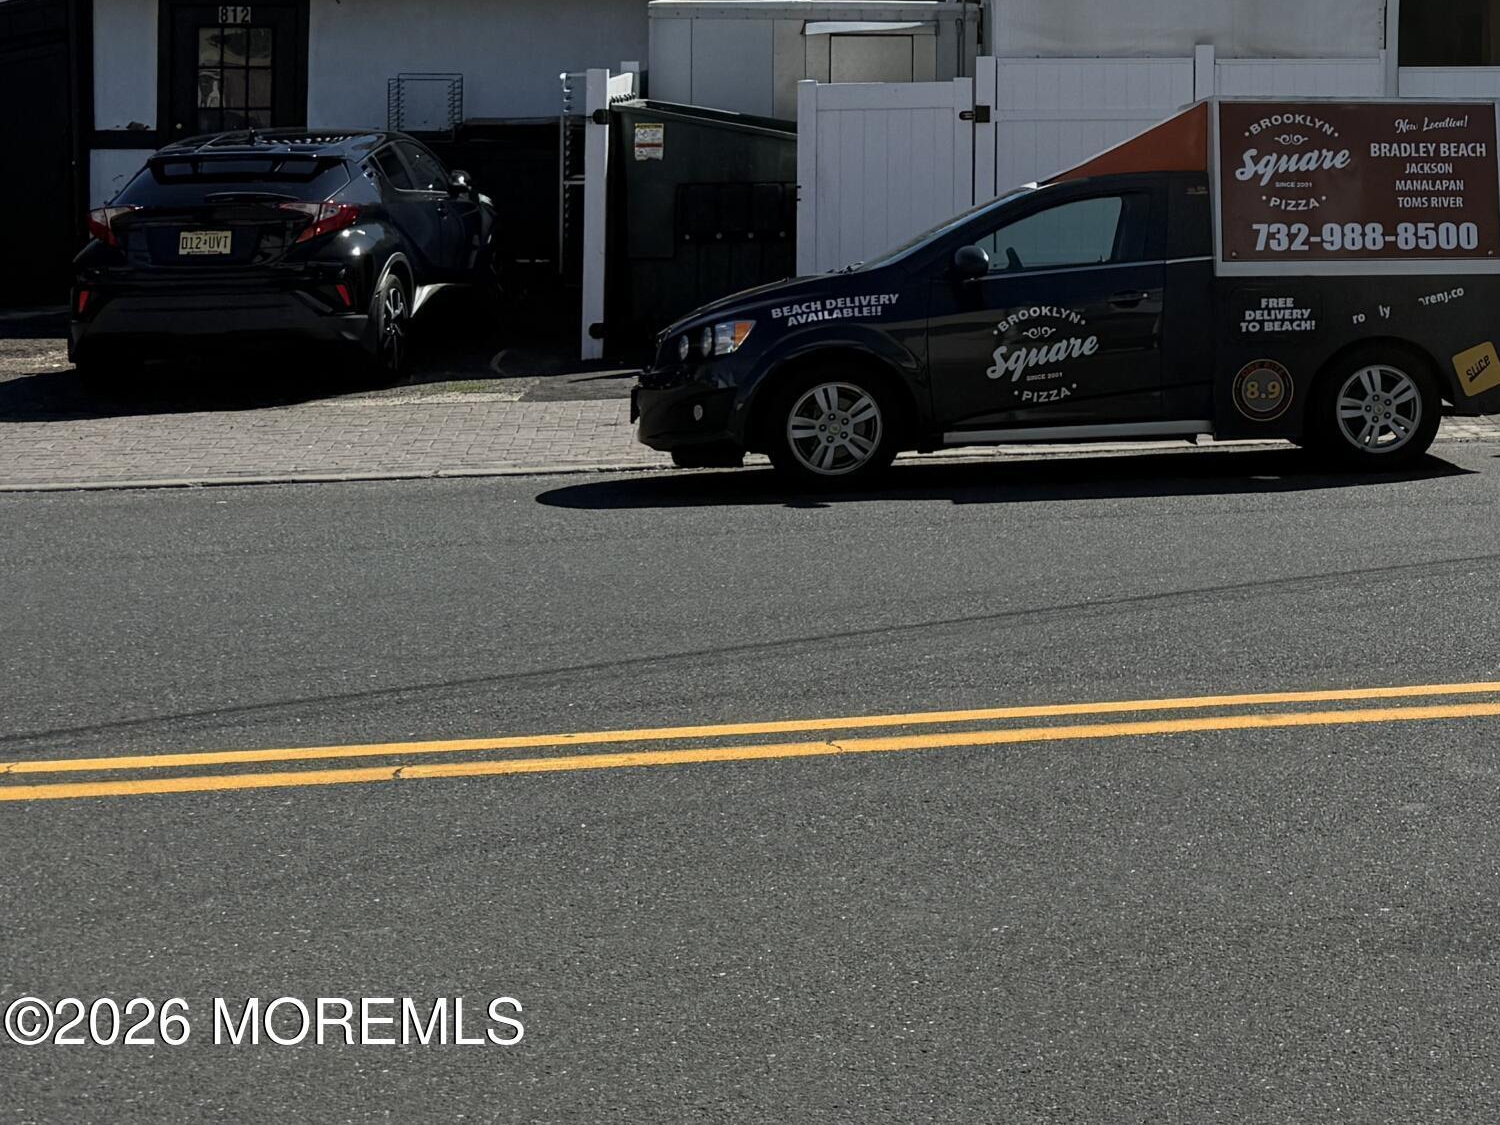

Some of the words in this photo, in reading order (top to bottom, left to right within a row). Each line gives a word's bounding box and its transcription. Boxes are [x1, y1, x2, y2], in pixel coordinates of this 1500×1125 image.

[221, 7, 249, 23] 812
[1250, 113, 1334, 135] BROOKLYN
[1370, 143, 1436, 157] BRADLEY
[1440, 143, 1486, 157] BEACH
[1235, 147, 1351, 186] Square
[1405, 162, 1453, 174] JACKSON
[1395, 179, 1464, 191] MANALAPAN
[1269, 196, 1320, 211] PIZZA
[1397, 196, 1429, 208] TOMS
[1430, 196, 1463, 208] RIVER
[1252, 221, 1479, 252] 732-988-8500
[771, 301, 822, 318] BEACH
[826, 293, 899, 309] DELIVERY
[1260, 297, 1294, 309] FREE
[787, 306, 882, 327] AVAILABLE!!
[997, 306, 1081, 332] BROOKLYN
[1244, 308, 1311, 321] DELIVERY
[1240, 321, 1260, 333] TO
[1264, 320, 1316, 332] BEACH!
[986, 335, 1099, 382] Square
[1021, 386, 1071, 402] PIZZA
[1246, 381, 1281, 399] 8.9
